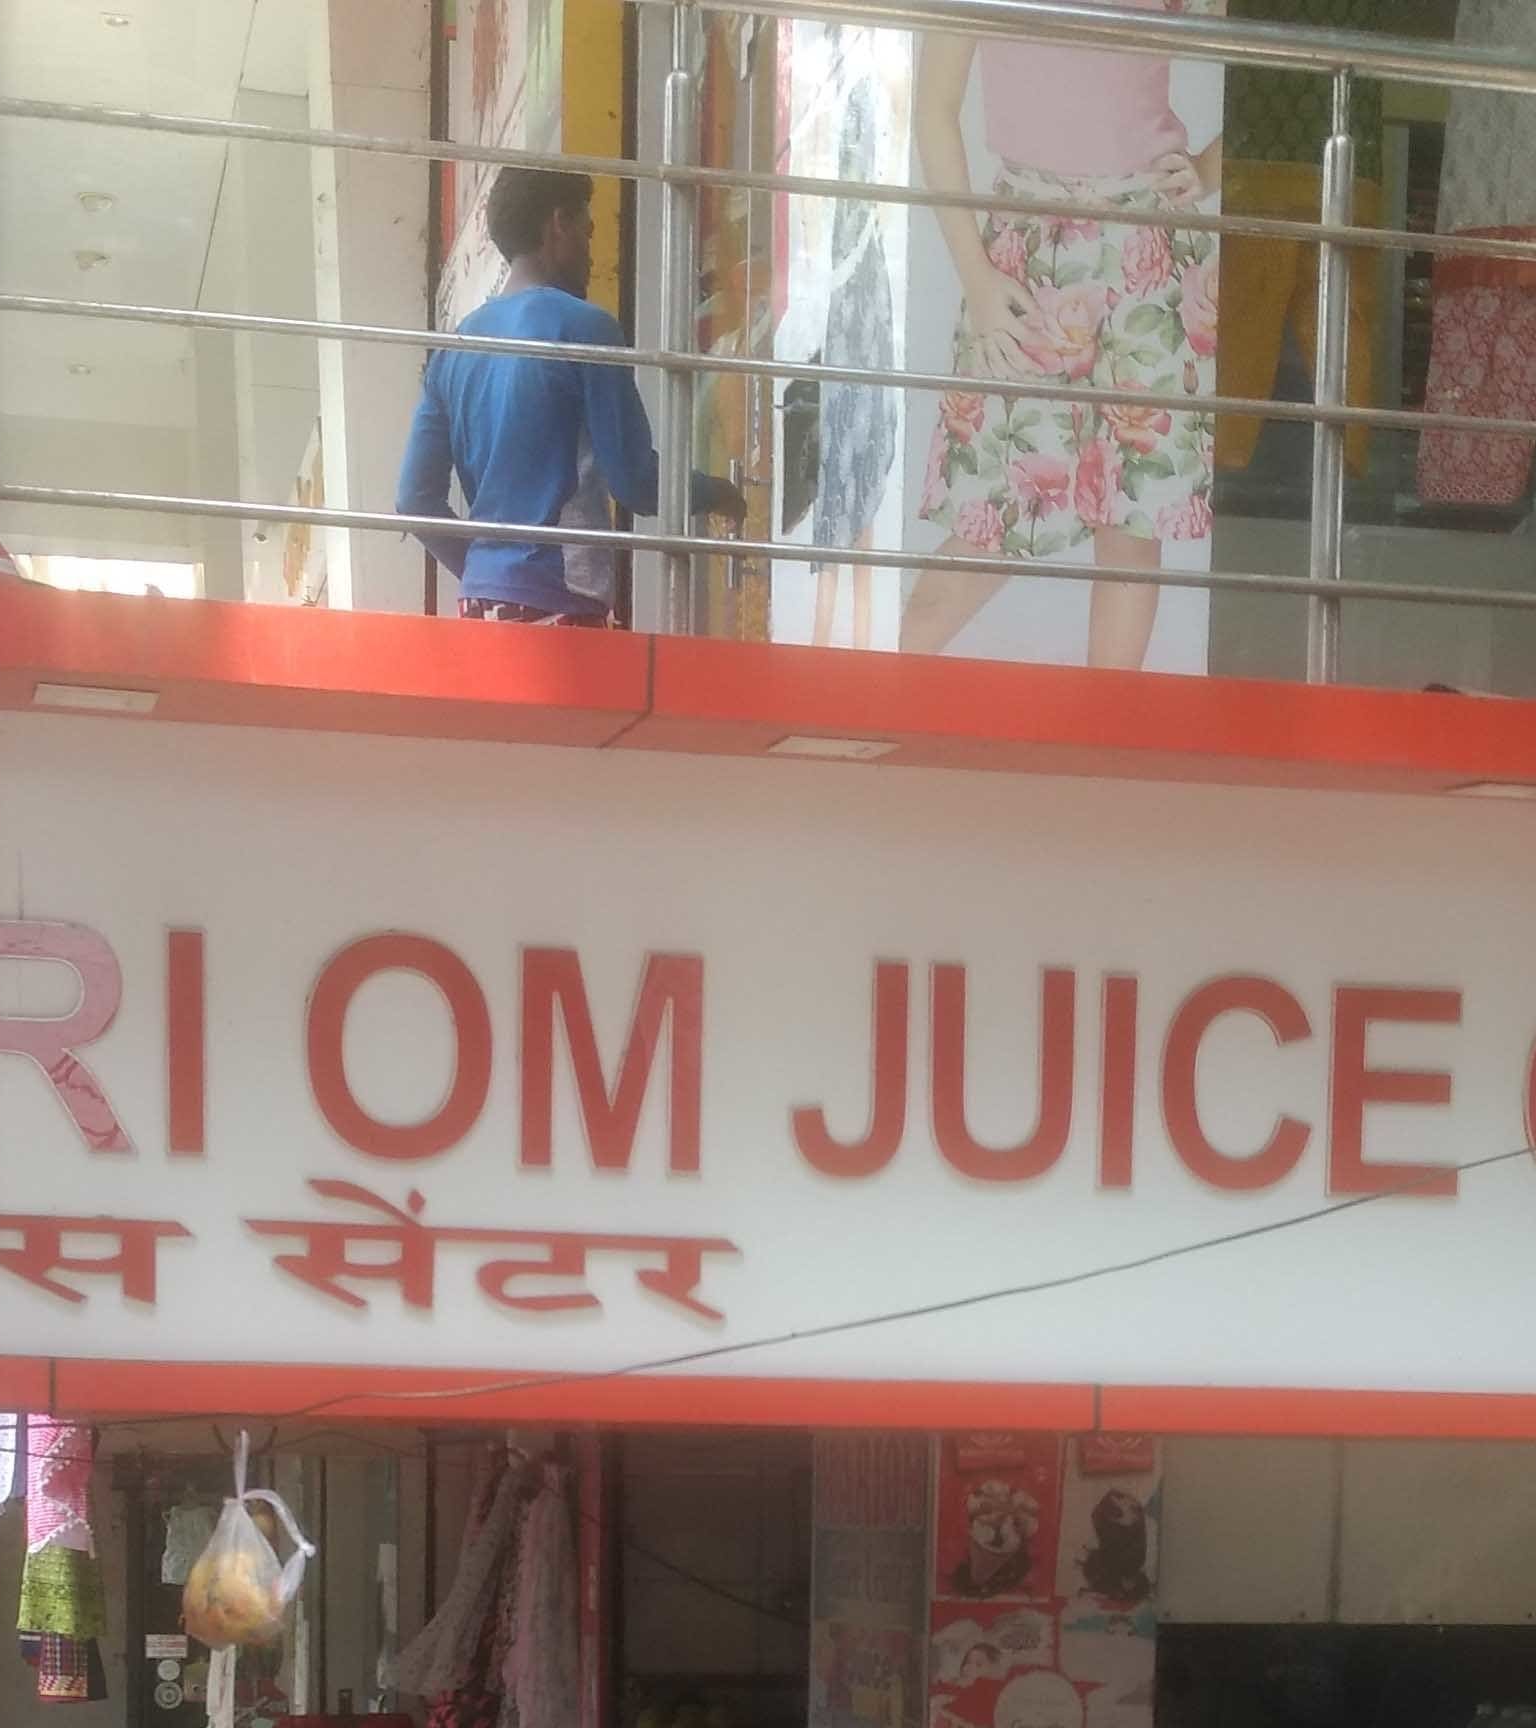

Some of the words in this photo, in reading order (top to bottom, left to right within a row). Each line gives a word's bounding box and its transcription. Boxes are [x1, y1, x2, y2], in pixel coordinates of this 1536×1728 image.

[304, 930, 706, 1173] OM
[790, 960, 1462, 1198] JUICE
[244, 1177, 742, 1322] सेंटर
